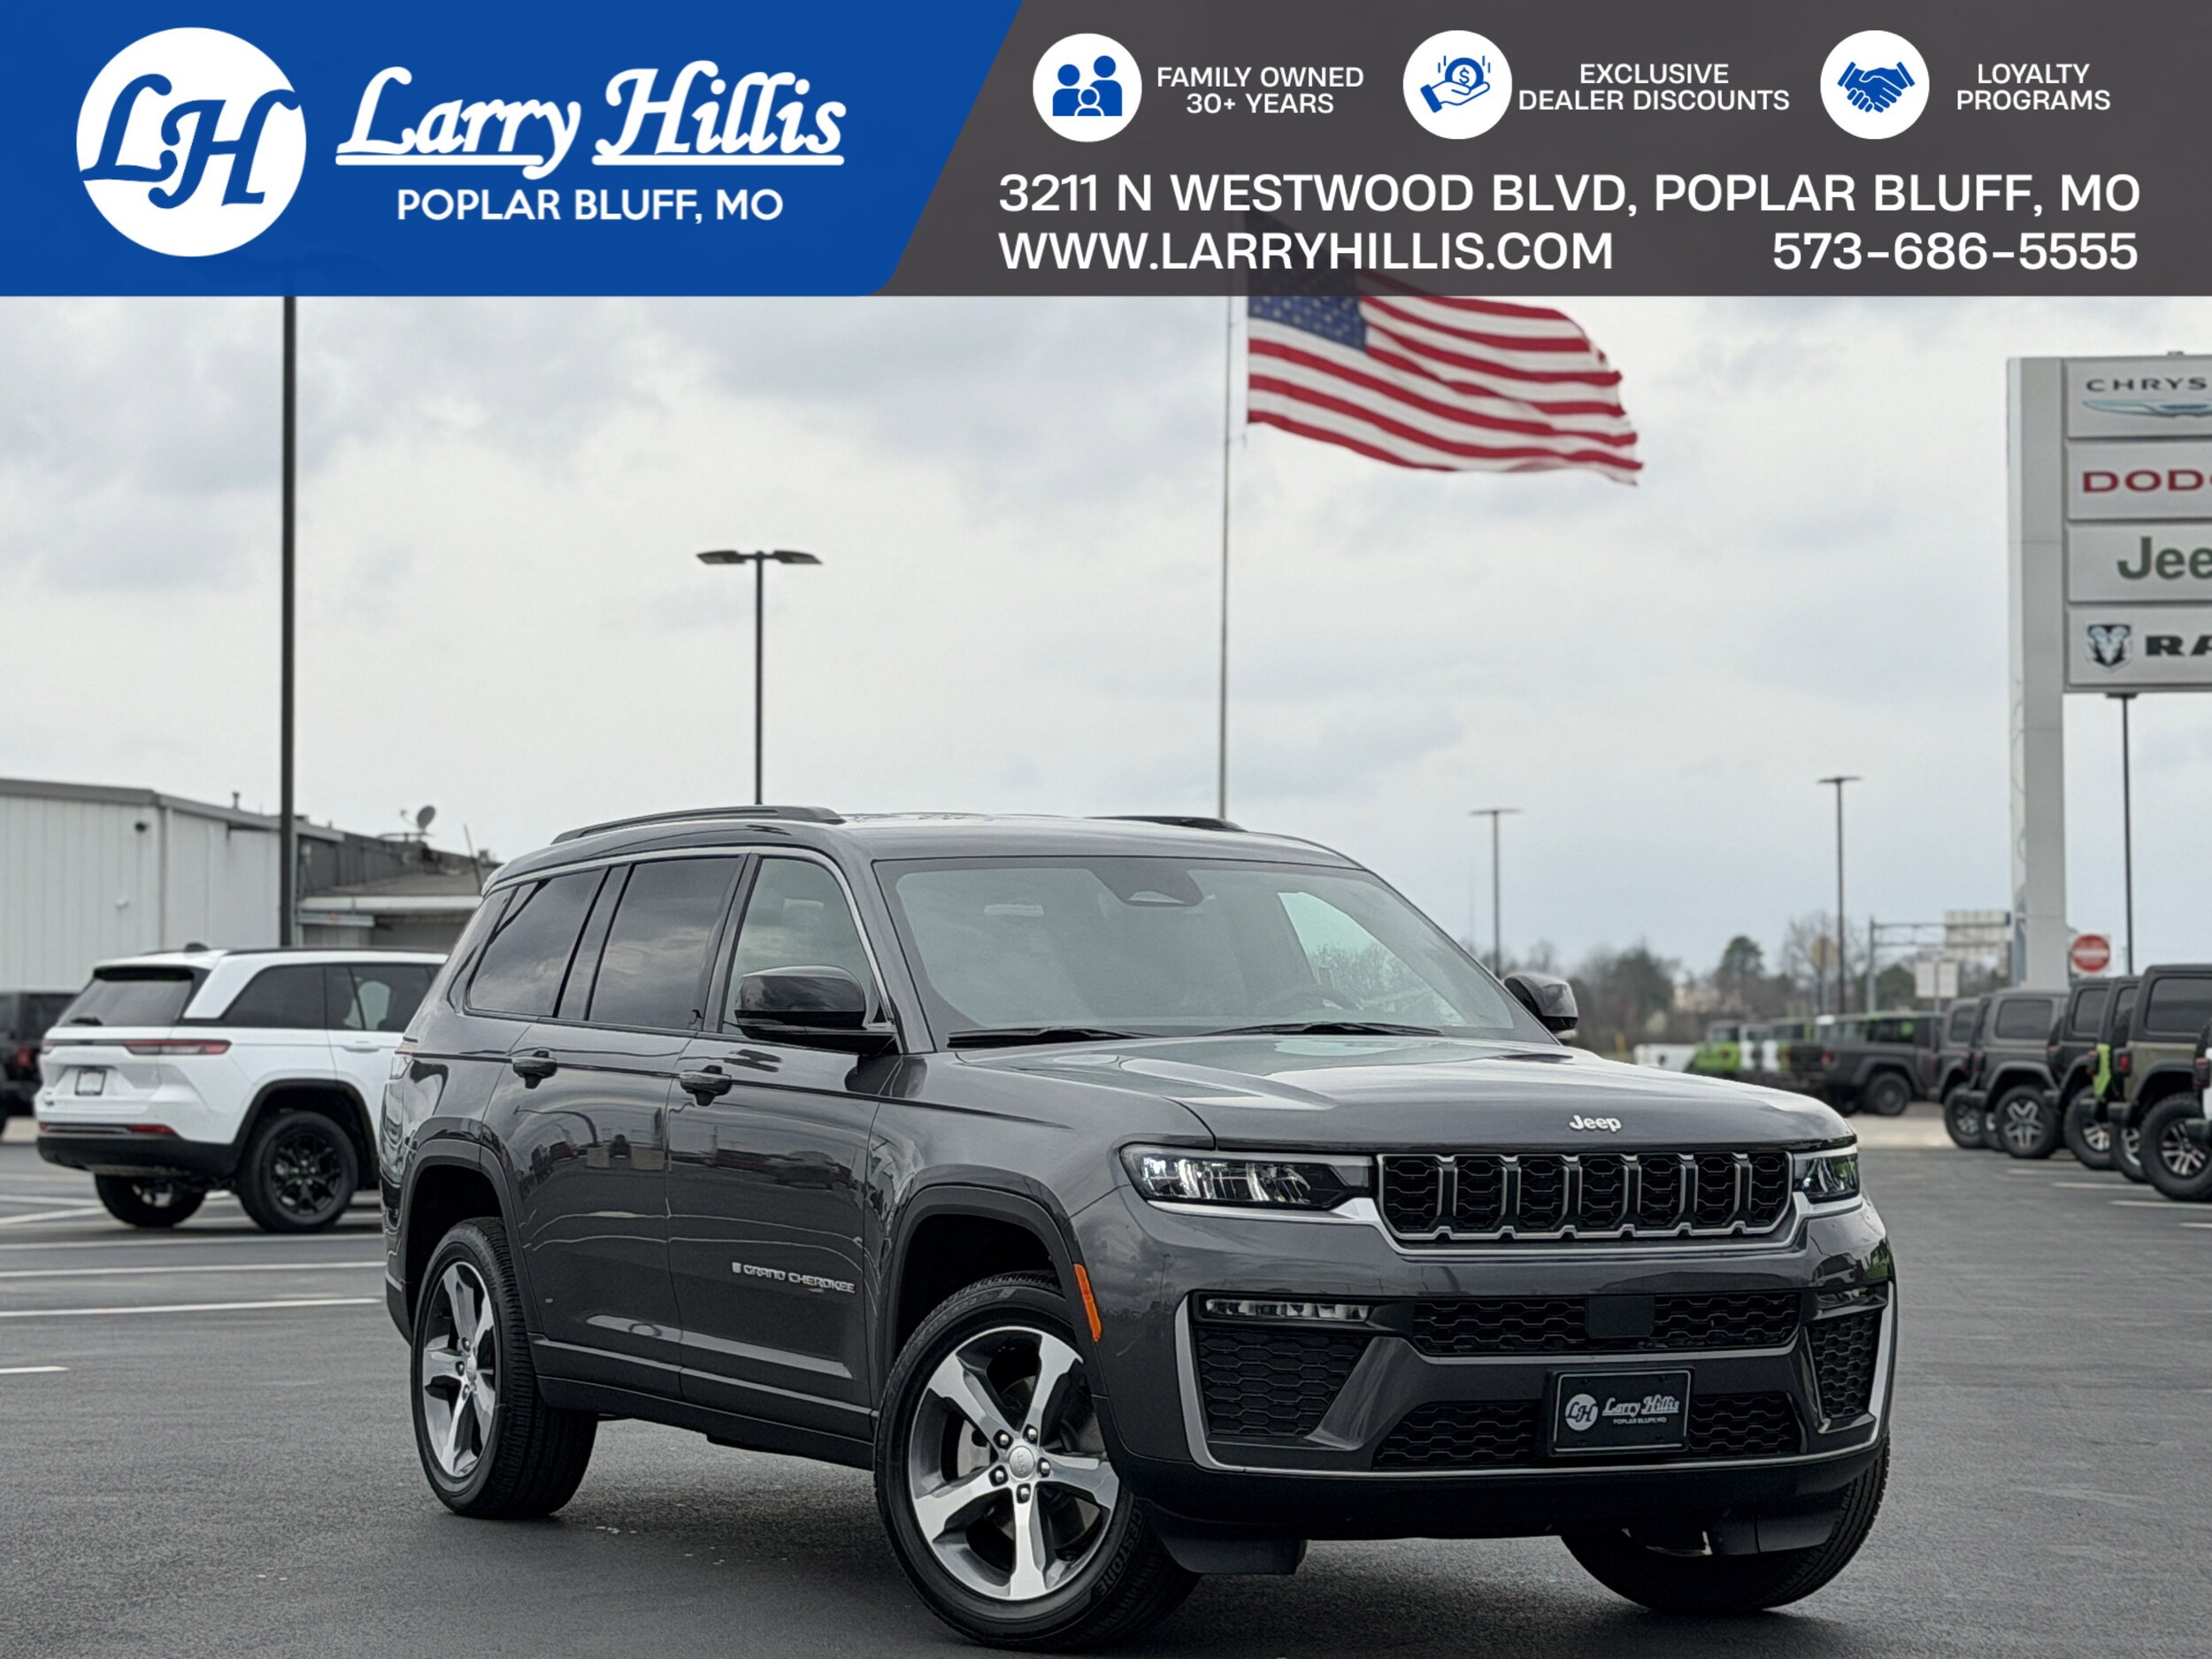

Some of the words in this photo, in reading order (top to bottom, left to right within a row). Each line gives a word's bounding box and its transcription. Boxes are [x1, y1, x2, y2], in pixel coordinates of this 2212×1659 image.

[2085, 377, 2207, 392] CHRYS
[2082, 469, 2212, 493] DOD
[1569, 1115, 1622, 1132] Jeep
[743, 1264, 786, 1281] GRAND
[788, 1272, 856, 1294] CHEROKEE
[1601, 1397, 1641, 1417] Larry
[1641, 1394, 1680, 1414] Hillis
